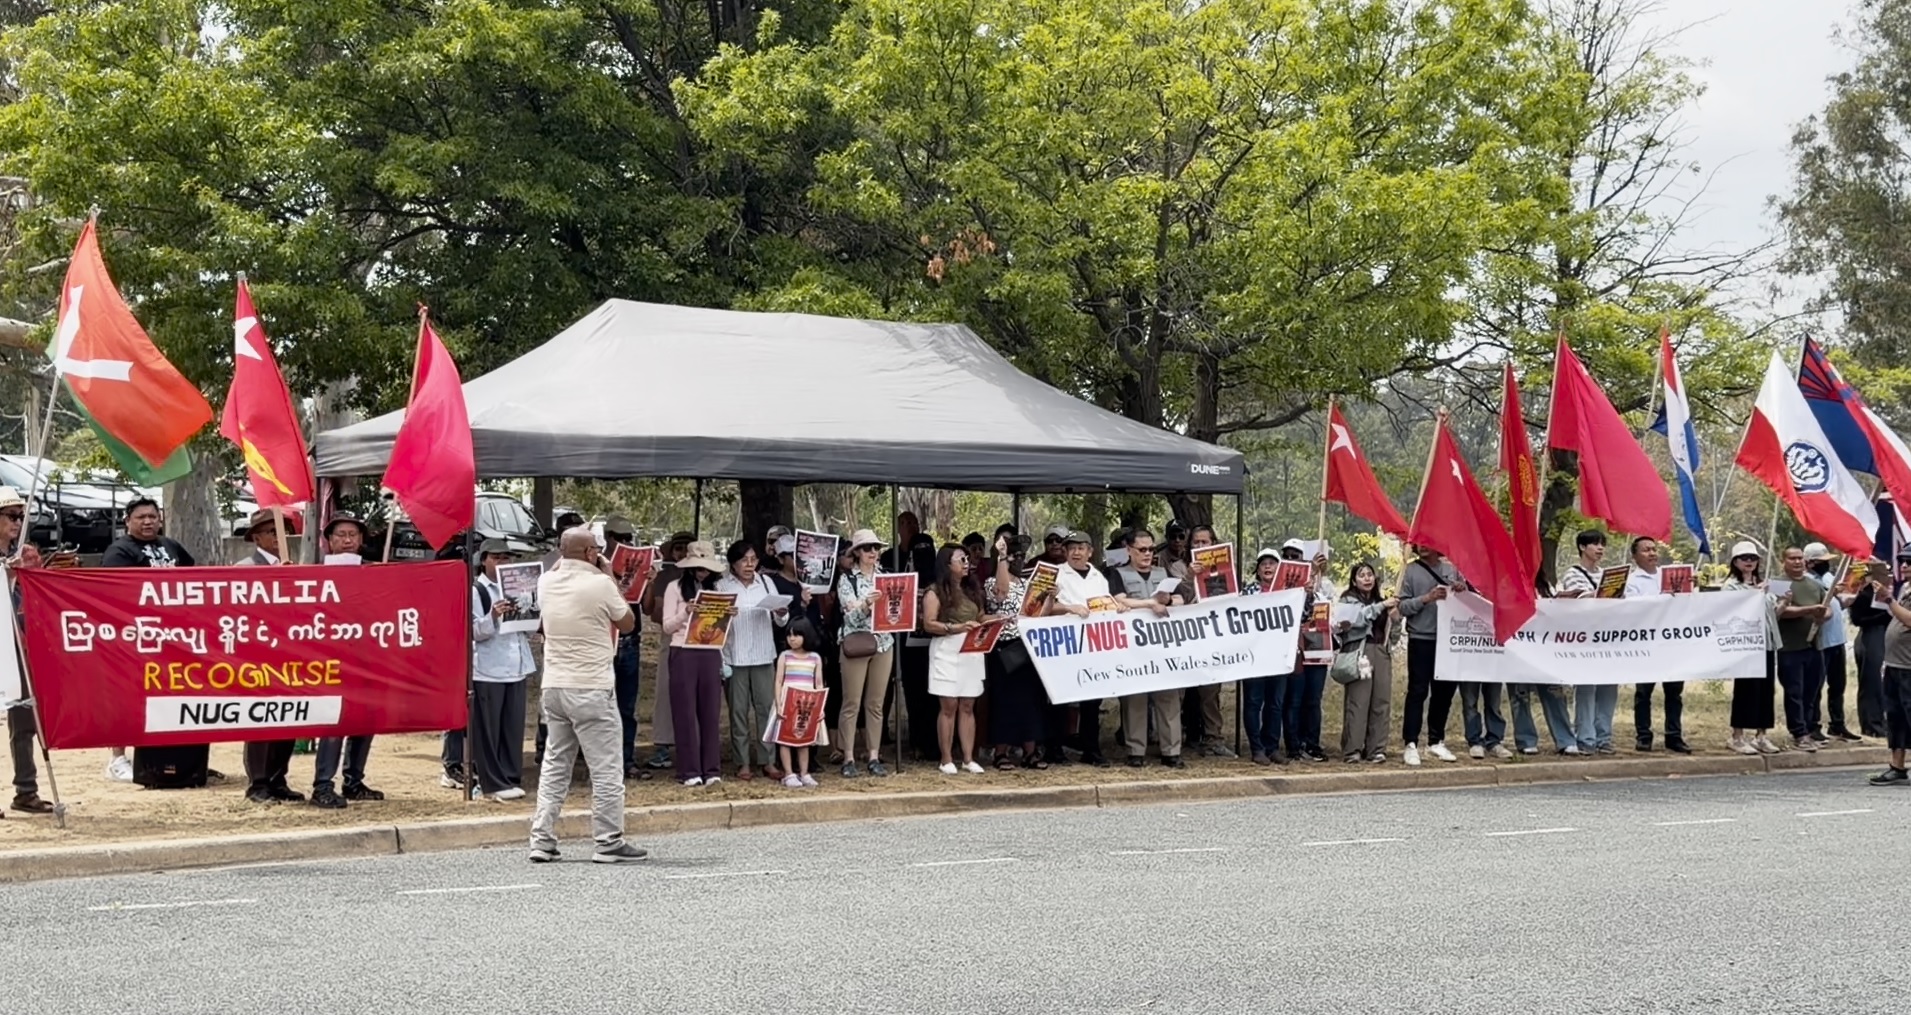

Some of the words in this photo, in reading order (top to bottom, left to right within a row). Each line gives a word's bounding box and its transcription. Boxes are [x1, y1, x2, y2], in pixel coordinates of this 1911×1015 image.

[1191, 464, 1220, 475] DUNE
[139, 580, 341, 606] AUSTRALIA
[1131, 609, 1223, 649] Support
[1225, 604, 1294, 633] Group
[1554, 631, 1587, 644] NUG
[1592, 628, 1656, 643] SUPPORT
[1661, 625, 1712, 640] GROUP
[144, 660, 342, 690] RECOGNISE
[1077, 667, 1111, 687] (New
[1115, 660, 1160, 679] South
[1165, 655, 1208, 672] Wales
[1211, 648, 1255, 667] State)
[179, 702, 241, 725] NUG
[248, 700, 309, 723] CRPH
